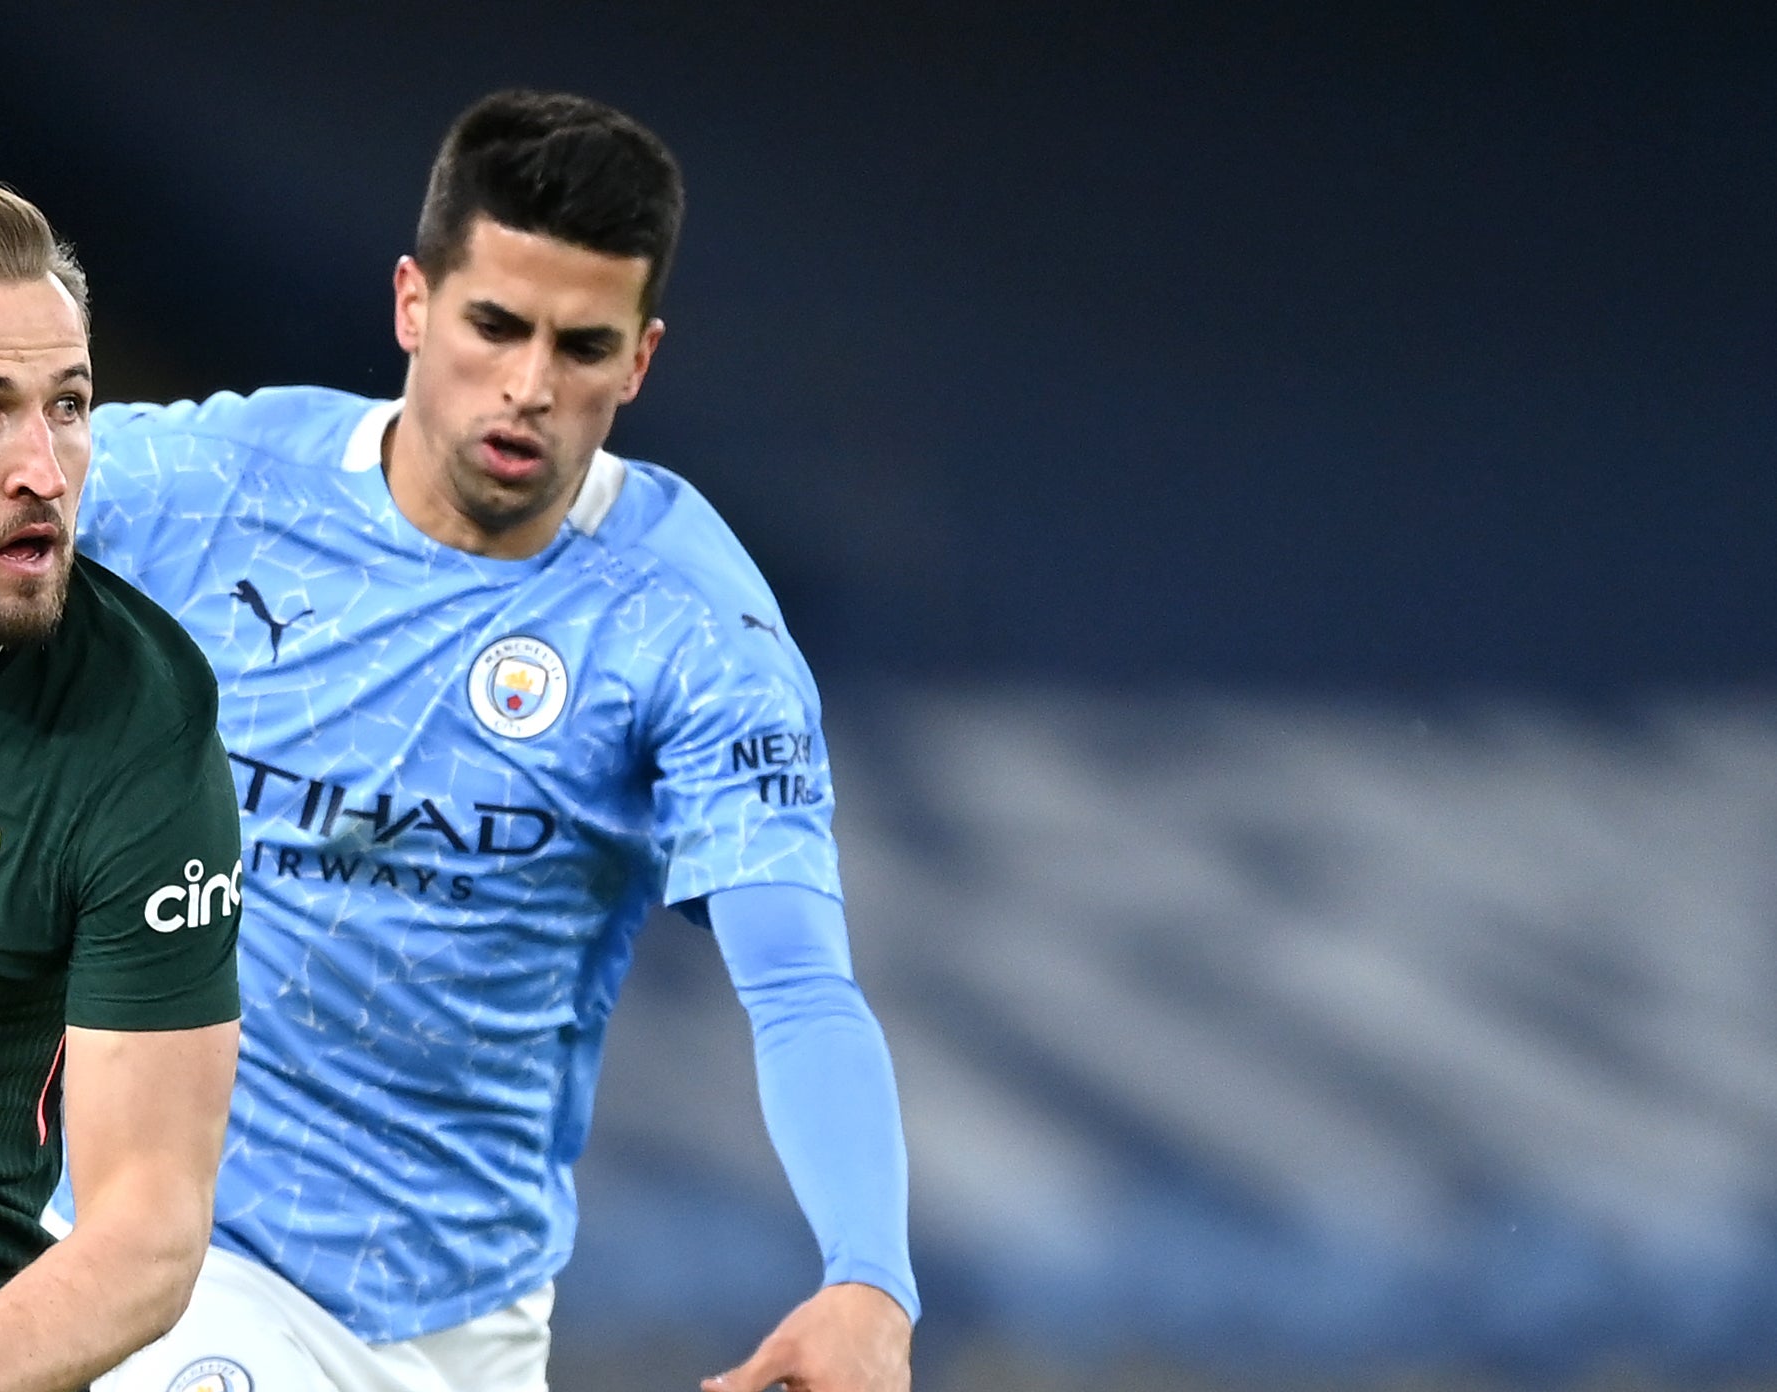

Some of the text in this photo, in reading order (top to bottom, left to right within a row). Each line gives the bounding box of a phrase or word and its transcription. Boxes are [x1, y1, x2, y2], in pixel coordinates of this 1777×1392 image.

[227, 752, 557, 856] TIHAD
[144, 859, 242, 933] cinc
[251, 841, 474, 901] IRWAYS
